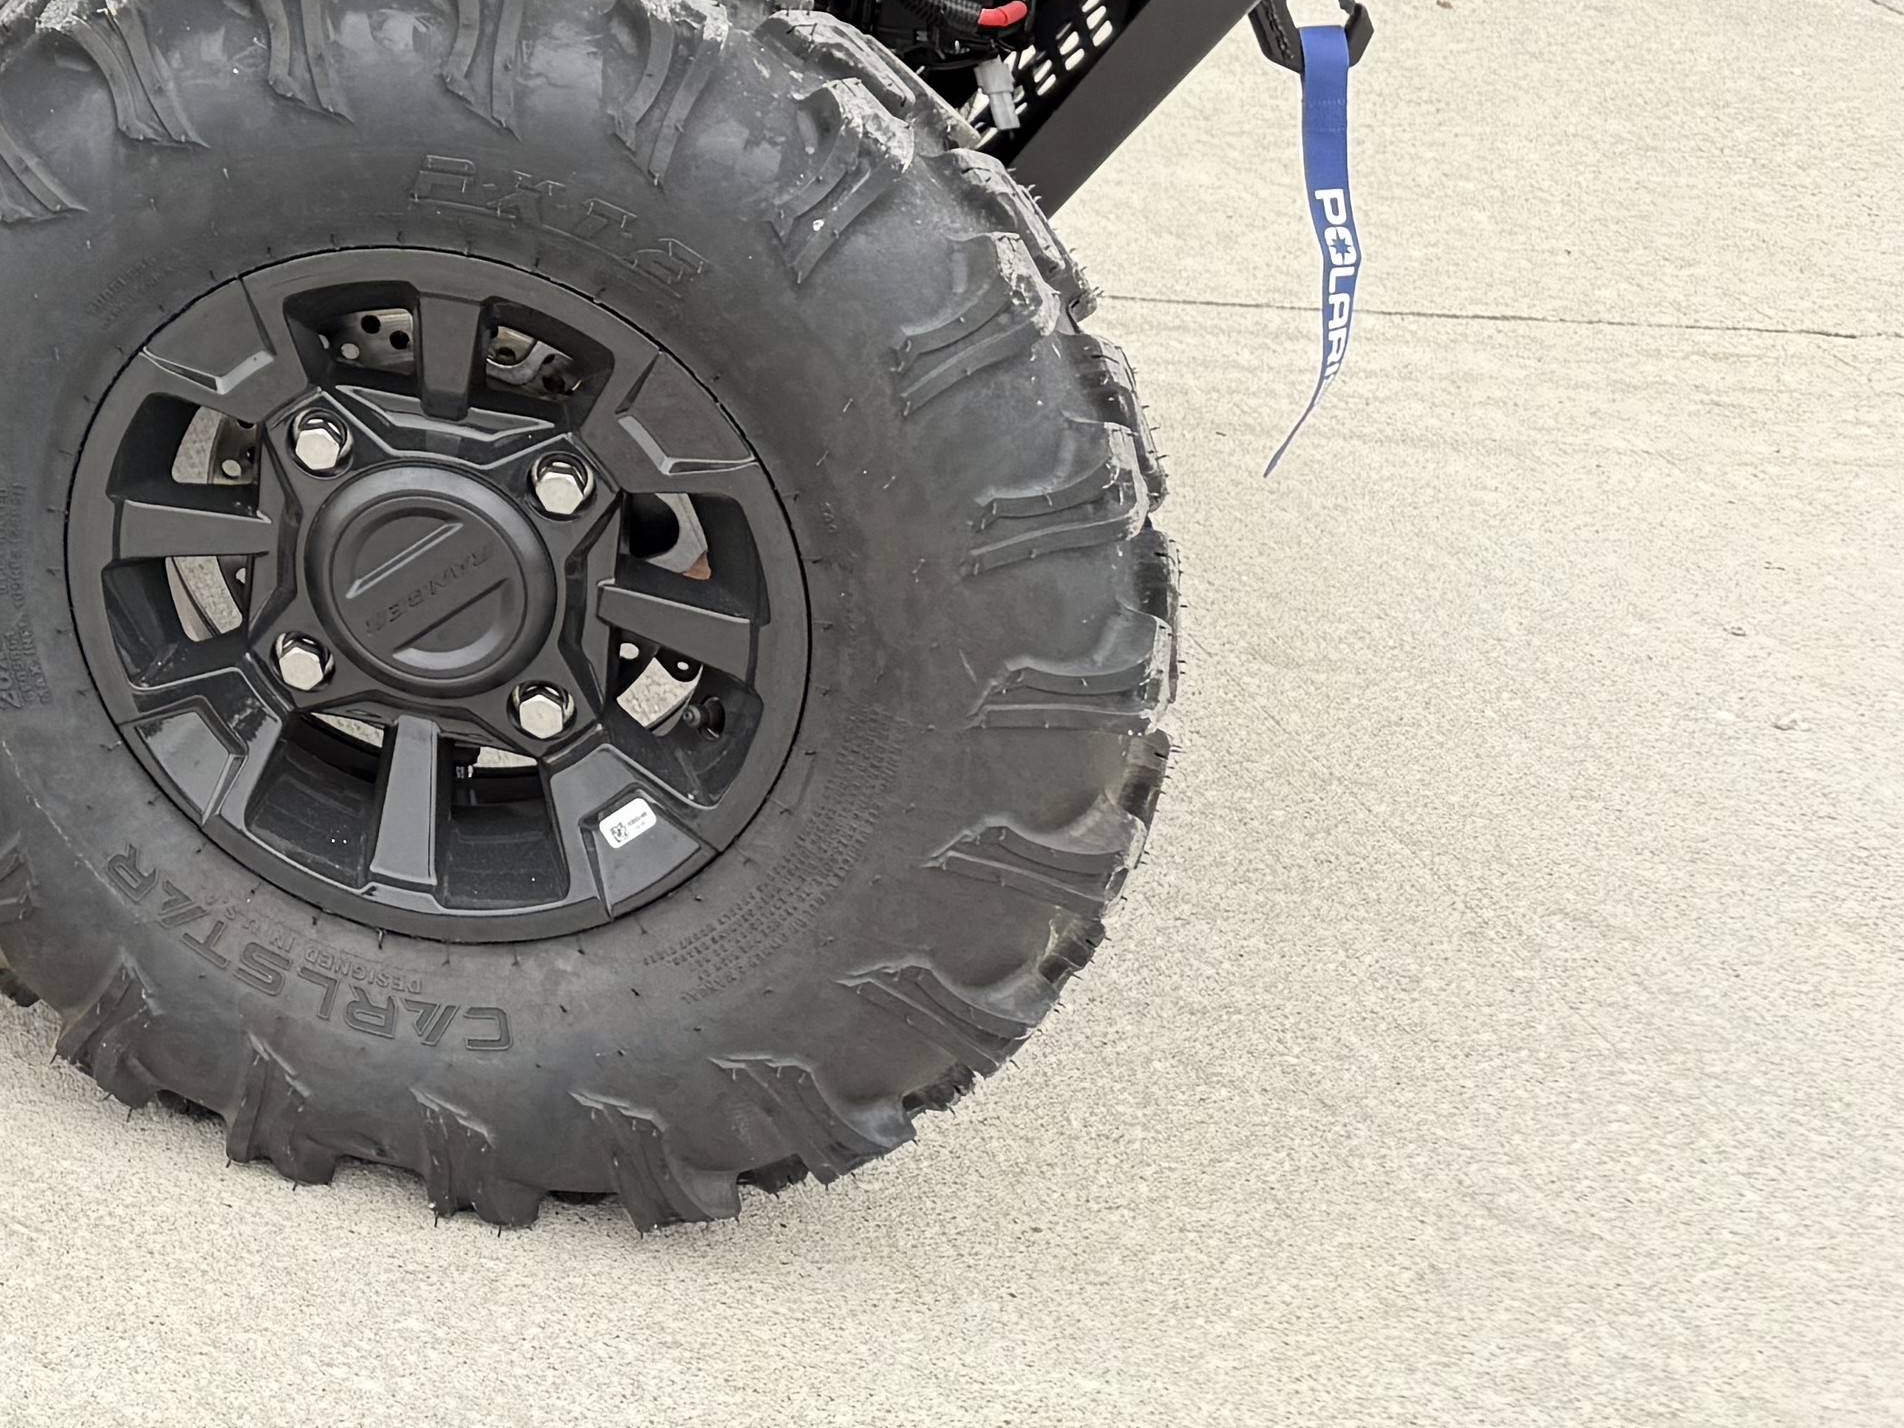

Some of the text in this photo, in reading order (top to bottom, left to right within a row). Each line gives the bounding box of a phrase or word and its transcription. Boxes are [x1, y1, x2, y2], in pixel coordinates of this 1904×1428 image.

[1314, 188, 1358, 404] POLARI
[105, 844, 514, 1051] CARLSTAR
[305, 946, 424, 994] DESIGNED
